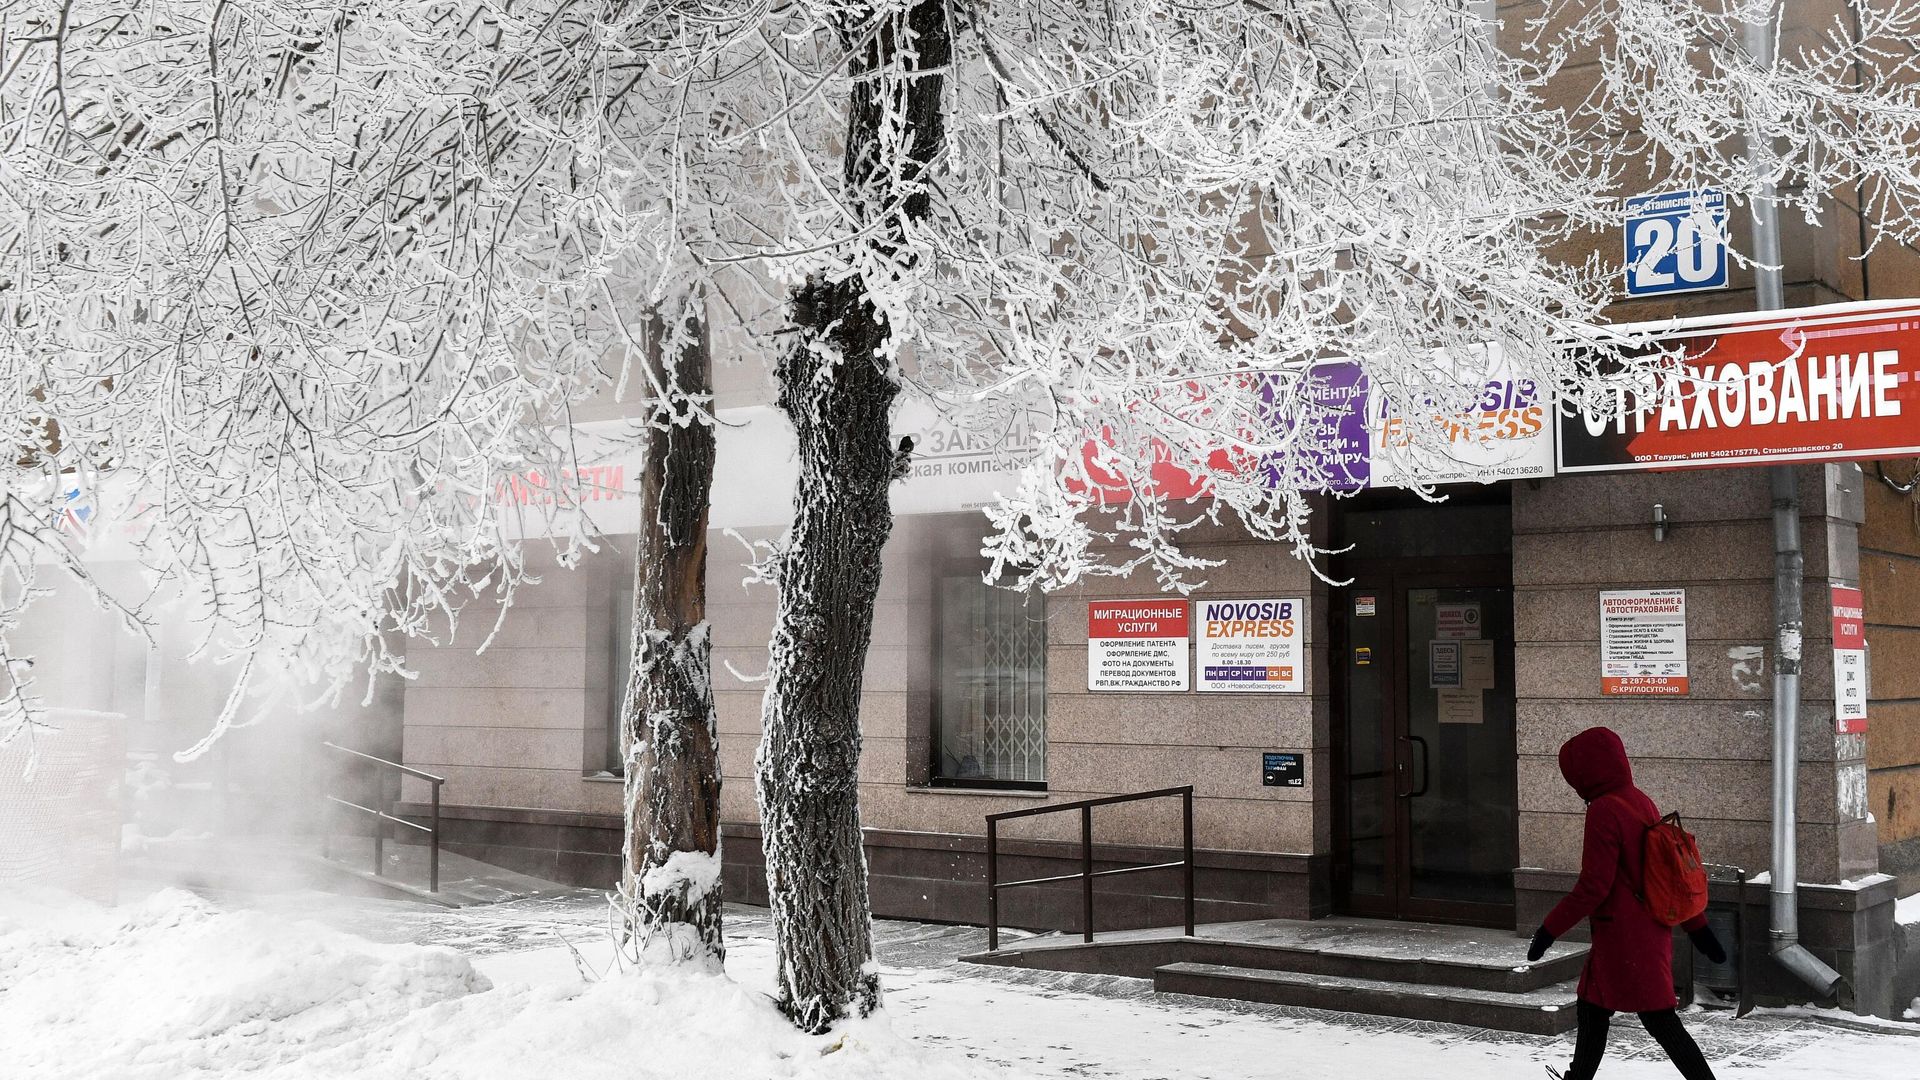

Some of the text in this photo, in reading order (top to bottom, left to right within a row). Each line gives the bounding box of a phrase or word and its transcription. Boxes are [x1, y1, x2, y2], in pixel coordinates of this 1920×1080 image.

[1634, 218, 1719, 288] 20
[1691, 451, 1709, 459] ИНН
[1711, 447, 1761, 458] 5402175779,
[1763, 444, 1831, 455] Станиславского
[1833, 442, 1844, 450] 20
[1603, 598, 1675, 606] АВТООФОРМЛЕНИЕ
[1094, 608, 1183, 620] МИГРАЦИОННЫЕ
[1206, 602, 1293, 621] NOVOSIB
[1606, 605, 1680, 614] АВТОСТРАХОВАНИЕ
[1117, 622, 1158, 633] УСЛУГИ
[1206, 619, 1295, 638] EXPRESS
[1153, 650, 1170, 658] ДМС,
[1278, 650, 1290, 659] руб
